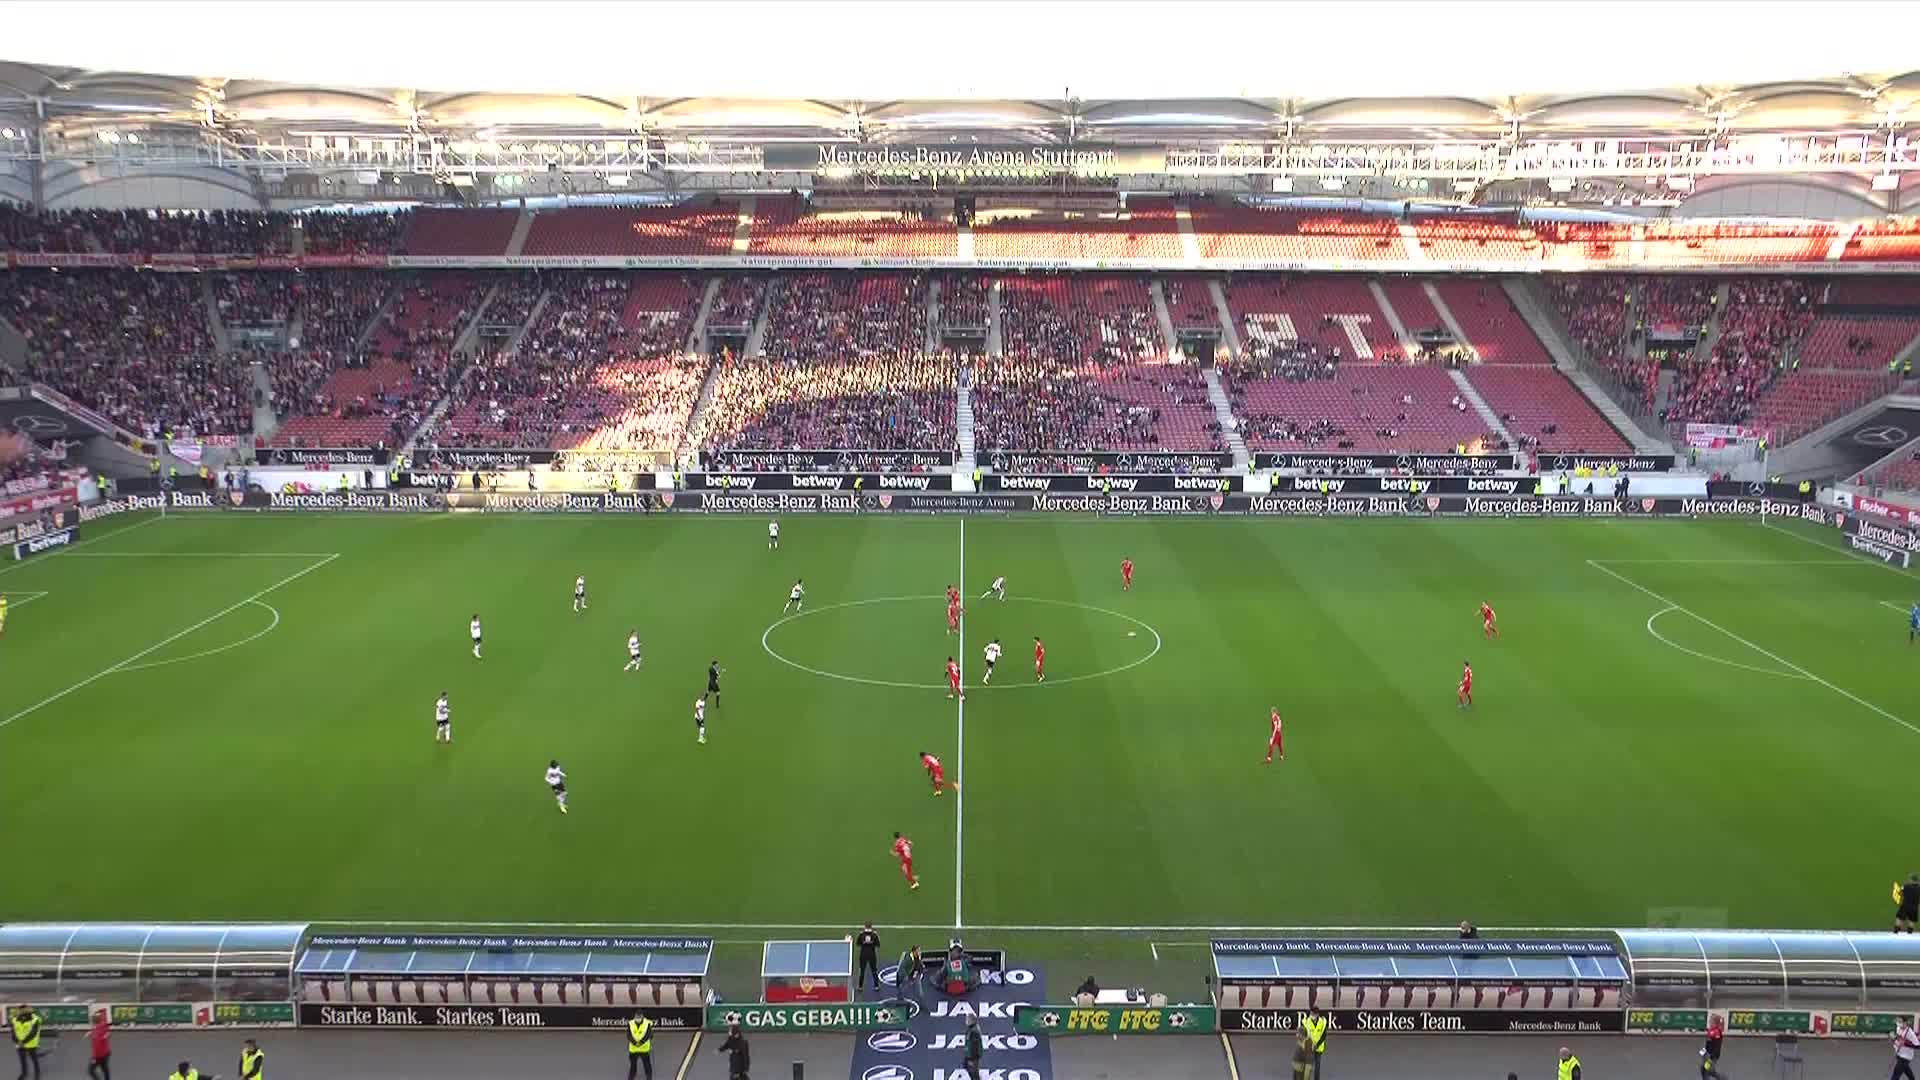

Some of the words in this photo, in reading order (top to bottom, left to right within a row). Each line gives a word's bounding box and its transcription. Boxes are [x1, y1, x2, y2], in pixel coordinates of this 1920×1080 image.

[817, 146, 963, 166] Mercedes-Benz
[970, 147, 1026, 166] Arena
[1031, 147, 1116, 170] Stuttgart
[291, 451, 373, 464] Mercedes-Benz
[1416, 457, 1498, 469] Mercedes-Benz
[792, 475, 843, 490] betway
[880, 475, 930, 490] betway
[1000, 476, 1051, 491] betway
[1174, 477, 1226, 492] betway
[1467, 479, 1519, 494] betway
[78, 491, 166, 523] Mercedes-Benz
[172, 491, 213, 507] Bank
[270, 492, 385, 507] Mercedes-Benz
[389, 492, 430, 507] Bank
[485, 493, 599, 509] Mercedes-Benz
[603, 493, 643, 508] Bank
[700, 493, 816, 509] Mercedes-Benz
[820, 493, 860, 508] Bank
[910, 496, 984, 507] Mercedes-Benz
[985, 497, 1016, 507] Arena
[1031, 495, 1147, 511] Mercedes-Benz
[1151, 496, 1191, 511] Bank
[1249, 497, 1364, 512] Mercedes-Benz
[1369, 497, 1409, 512] Bank
[1464, 497, 1579, 513] Mercedes-Benz
[1583, 498, 1623, 513] Bank
[1681, 498, 1800, 518] Mercedes-Benz
[1801, 503, 1827, 526] Bank
[1852, 535, 1894, 563] betway
[312, 936, 382, 946] Mercedes-Benz
[382, 937, 408, 946] Bank
[412, 937, 482, 946] Mercedes-Benz
[483, 938, 508, 946] Bank
[512, 938, 582, 947] Mercedes-Benz
[584, 938, 608, 947] Bank
[613, 939, 683, 948] Mercedes-Benz
[684, 940, 709, 949] Bank
[1214, 943, 1284, 951] Mercedes-Benz
[1285, 943, 1311, 951] Bank
[1315, 943, 1385, 951] Mercedes-Benz
[1386, 943, 1412, 951] Bank
[1416, 943, 1486, 951] Mercedes-Benz
[1486, 943, 1512, 951] Bank
[1516, 943, 1587, 951] Mercedes-Benz
[1587, 943, 1613, 951] Bank
[320, 1006, 372, 1025] Starke
[376, 1006, 423, 1025] Bank.
[436, 1007, 494, 1025] Starkes
[498, 1007, 546, 1027] Team.
[661, 1017, 685, 1027] Bank
[745, 1010, 787, 1027] GAS
[792, 1007, 871, 1026] GEBA!!!
[1241, 1011, 1292, 1030] Starke
[1356, 1011, 1415, 1031] Starkes
[1420, 1012, 1466, 1031] Team.
[1509, 1021, 1577, 1031] Mercedes-Benz
[1578, 1021, 1602, 1032] Bank
